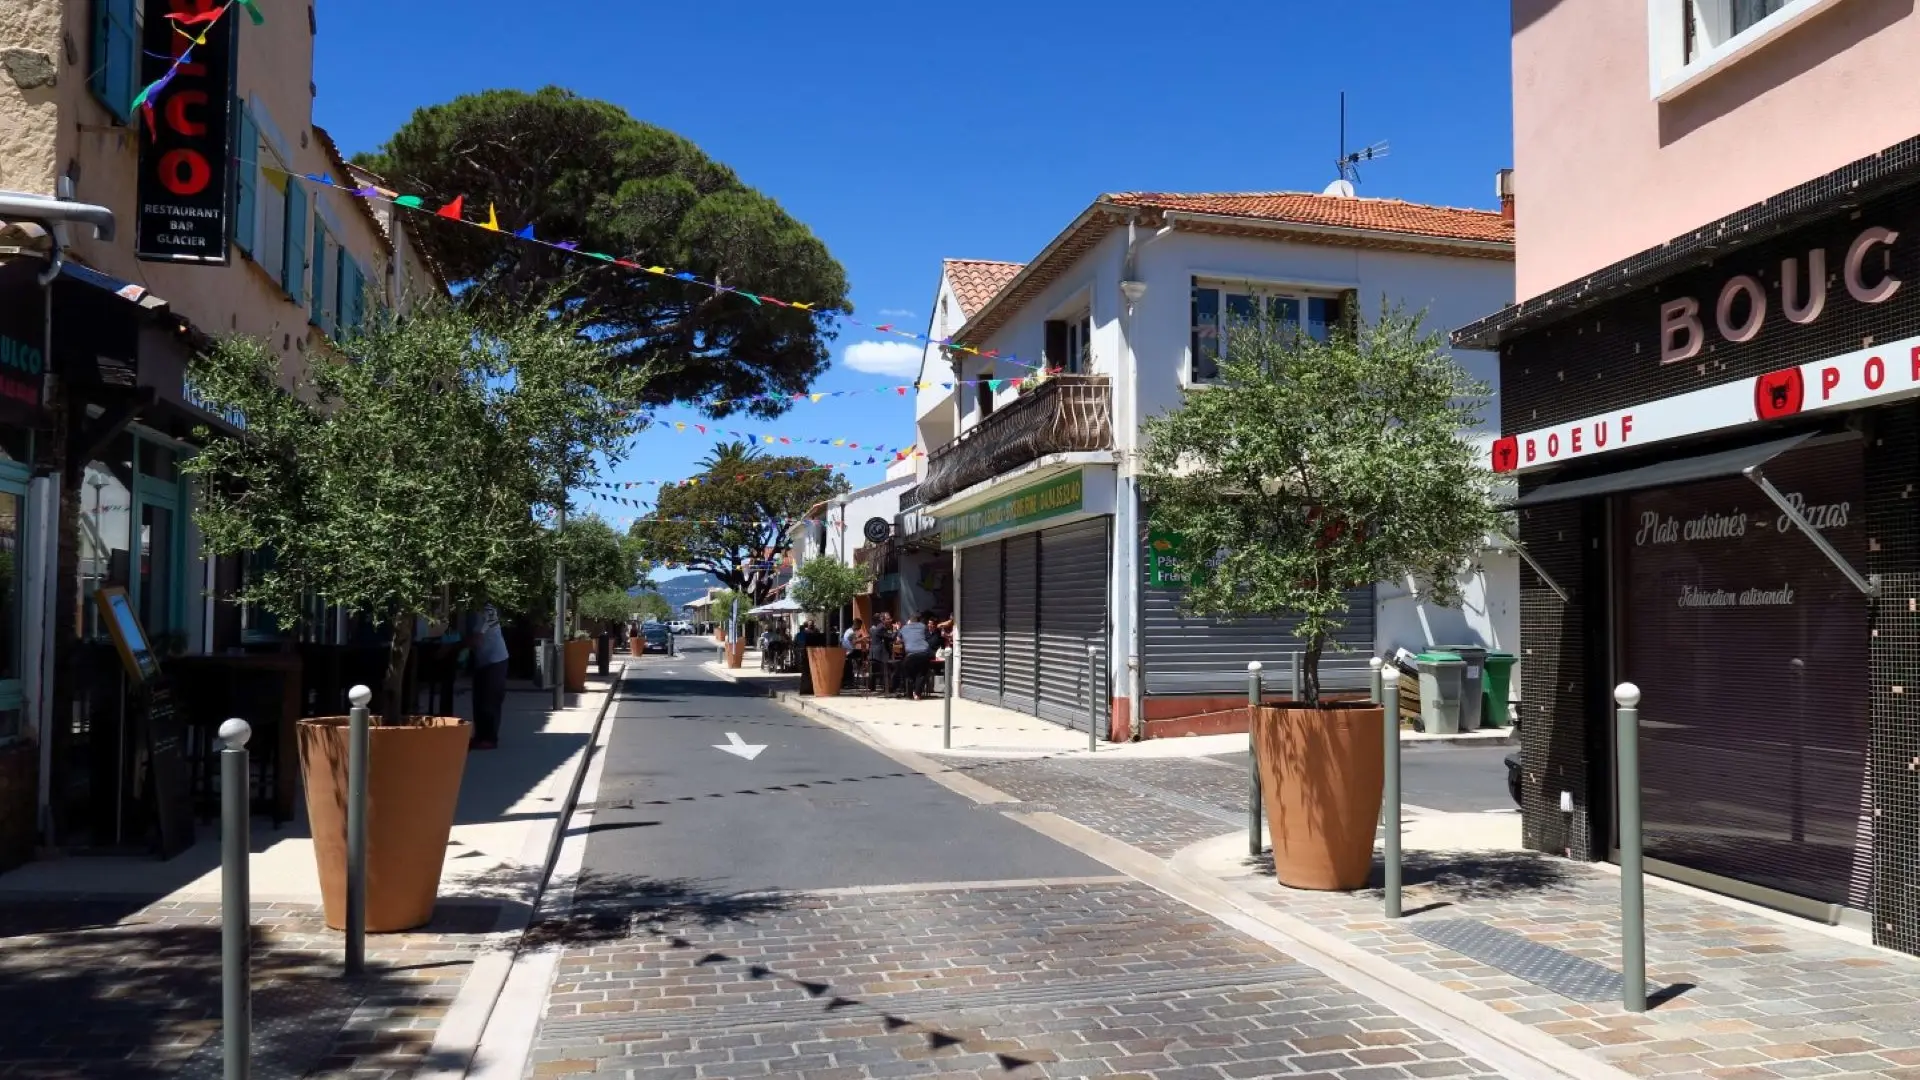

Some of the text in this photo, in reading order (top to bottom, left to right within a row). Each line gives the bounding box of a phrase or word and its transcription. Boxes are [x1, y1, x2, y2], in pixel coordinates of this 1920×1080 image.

[144, 204, 221, 219] RESTAURANT
[169, 220, 194, 231] BAR
[156, 233, 206, 247] GLACIER
[1660, 226, 1902, 366] BOUC
[1526, 415, 1634, 463] BOEUF
[1636, 511, 1680, 546] Plats
[1684, 506, 1748, 541] cuisinés
[1678, 582, 1794, 607] Fabrication artisanale
